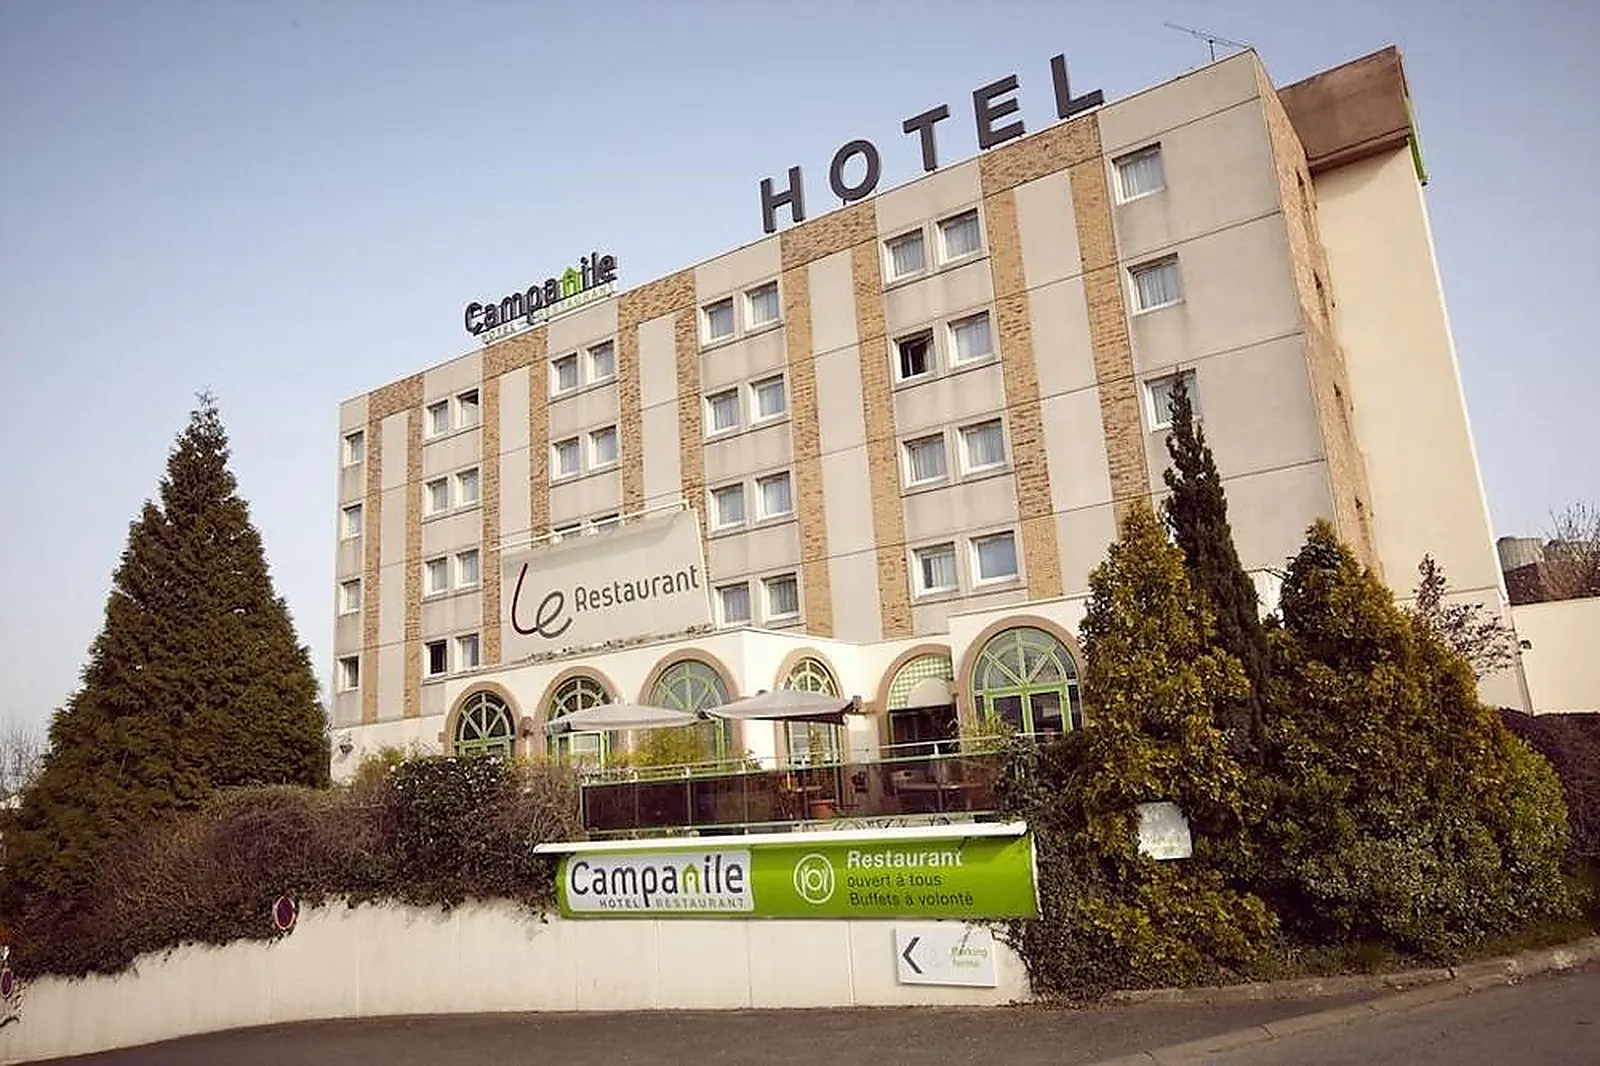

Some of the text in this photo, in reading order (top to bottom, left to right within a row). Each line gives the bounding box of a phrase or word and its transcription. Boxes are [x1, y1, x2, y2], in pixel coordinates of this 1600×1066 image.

[759, 53, 1104, 234] HOTEL
[464, 251, 619, 337] Campanile
[512, 562, 700, 639] Le Restaurant
[847, 850, 964, 869] Restaurant
[571, 854, 744, 908] Campanile
[847, 875, 891, 888] ouvert
[909, 873, 942, 887] tous
[599, 898, 745, 909] HOTEL RESTAURANT
[849, 892, 900, 907] Buffets
[918, 891, 974, 907] volonté
